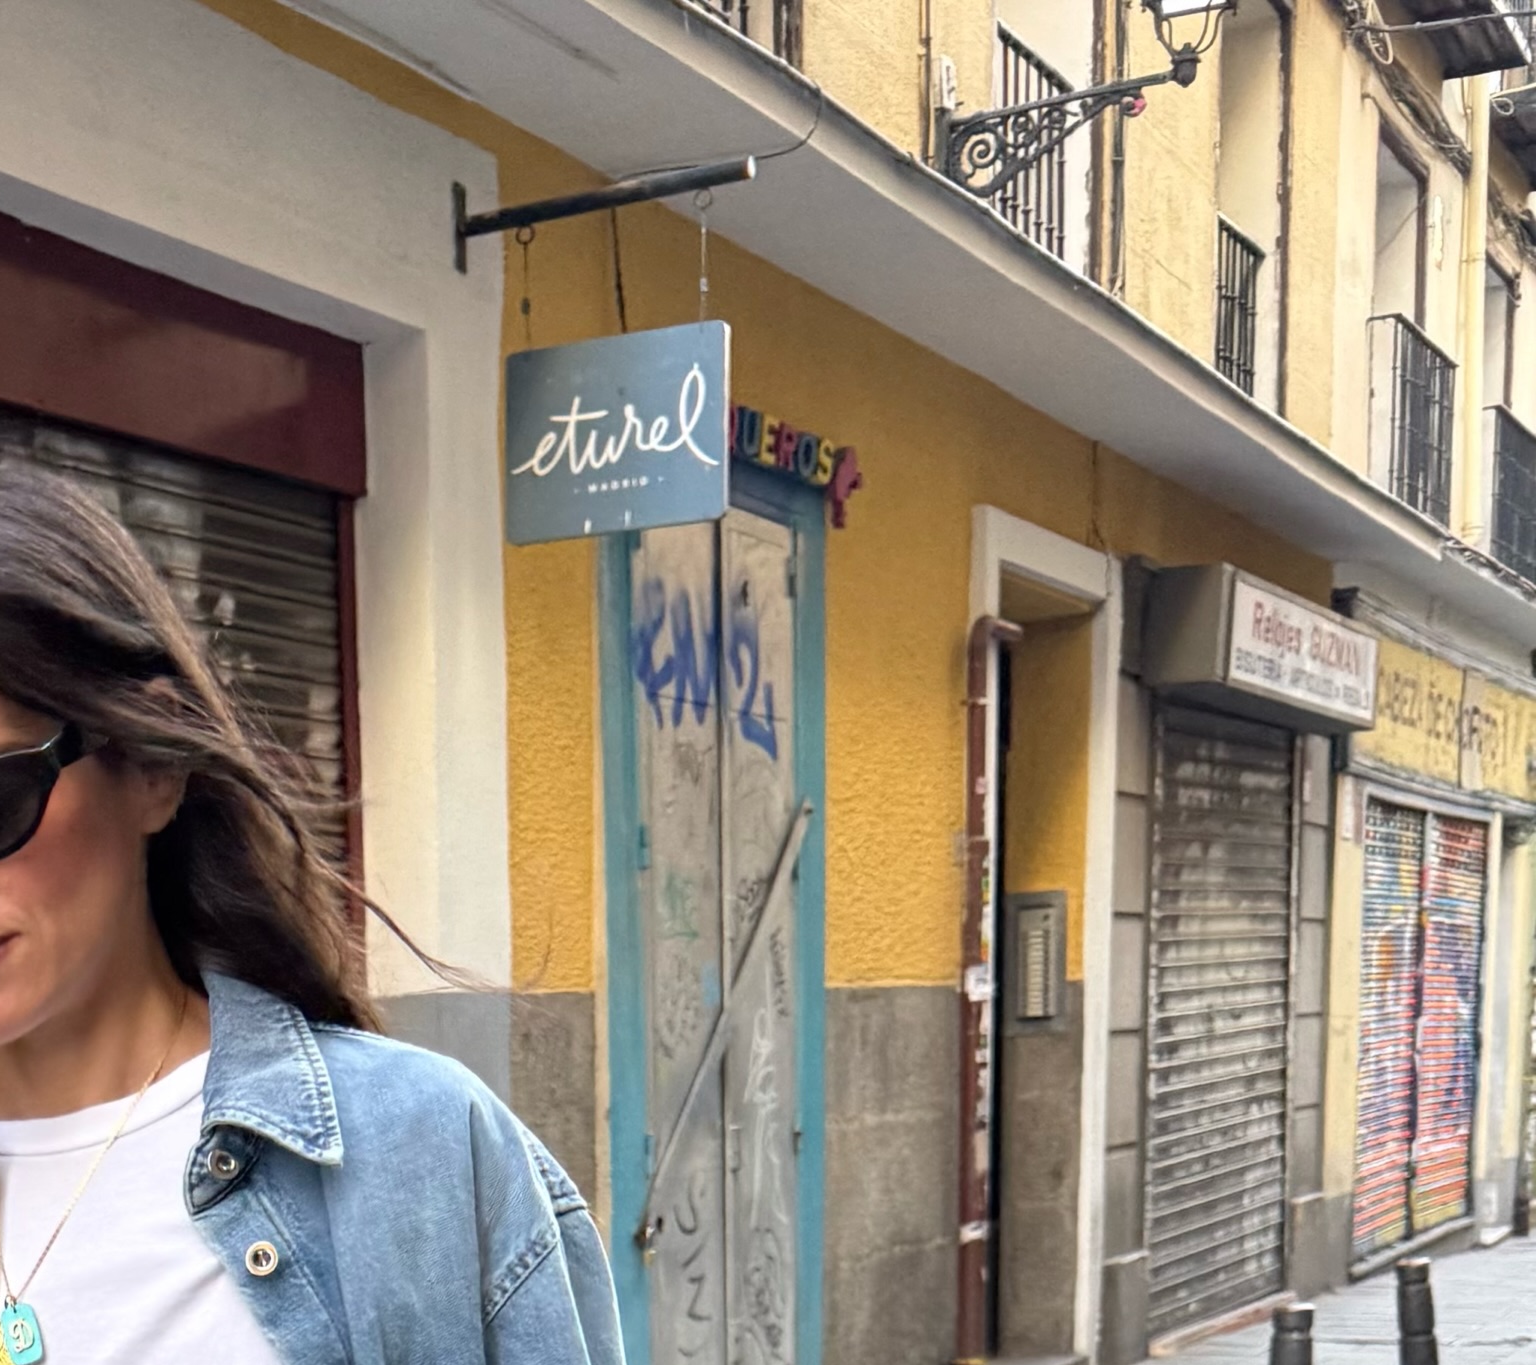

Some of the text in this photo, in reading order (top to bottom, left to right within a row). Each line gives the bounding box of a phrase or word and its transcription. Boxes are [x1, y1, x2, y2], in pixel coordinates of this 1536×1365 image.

[510, 362, 720, 477] eturel
[731, 405, 835, 487] UEROS
[587, 475, 649, 494] MADRID
